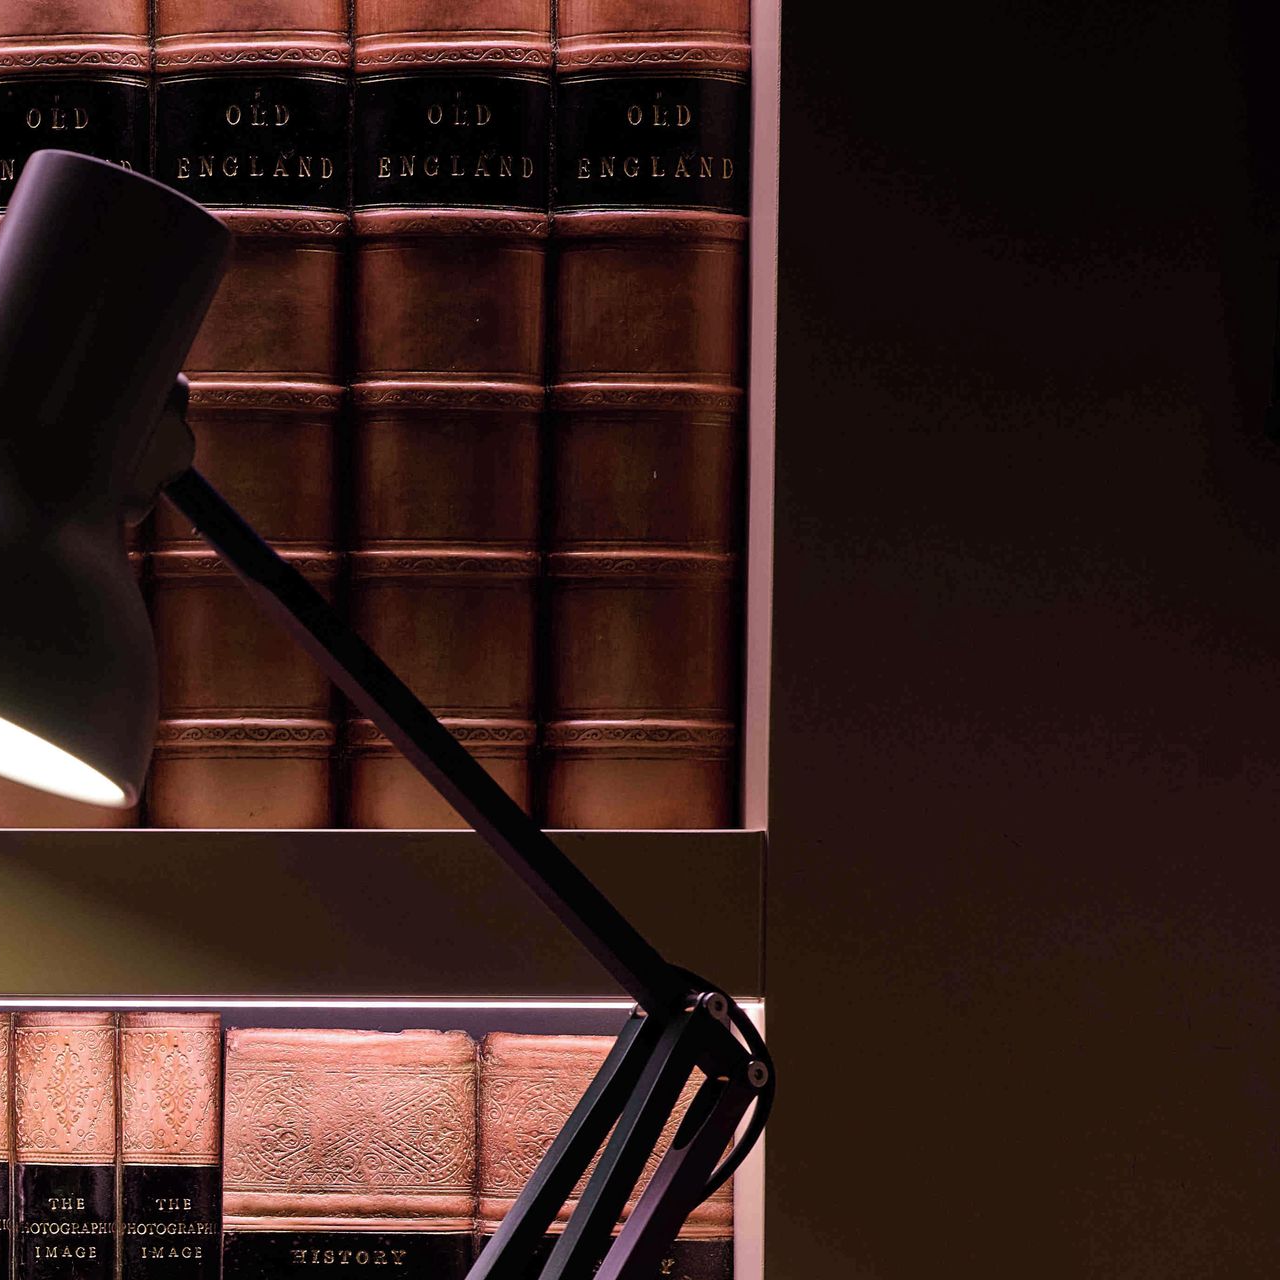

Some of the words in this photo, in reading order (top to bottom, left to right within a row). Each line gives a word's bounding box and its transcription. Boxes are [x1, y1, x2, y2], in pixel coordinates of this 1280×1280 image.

[26, 107, 90, 130] OLD
[225, 104, 290, 127] OLD
[427, 104, 492, 127] OLD
[626, 104, 692, 127] OLD
[176, 155, 334, 179] ENGLAND
[377, 155, 534, 179] ENGLAND
[577, 155, 734, 180] ENGLAND
[48, 1197, 86, 1210] THE
[155, 1198, 192, 1211] THE
[35, 1246, 97, 1260] IMAGE
[141, 1246, 203, 1259] IMAGE
[290, 1249, 408, 1266] HISTORY
